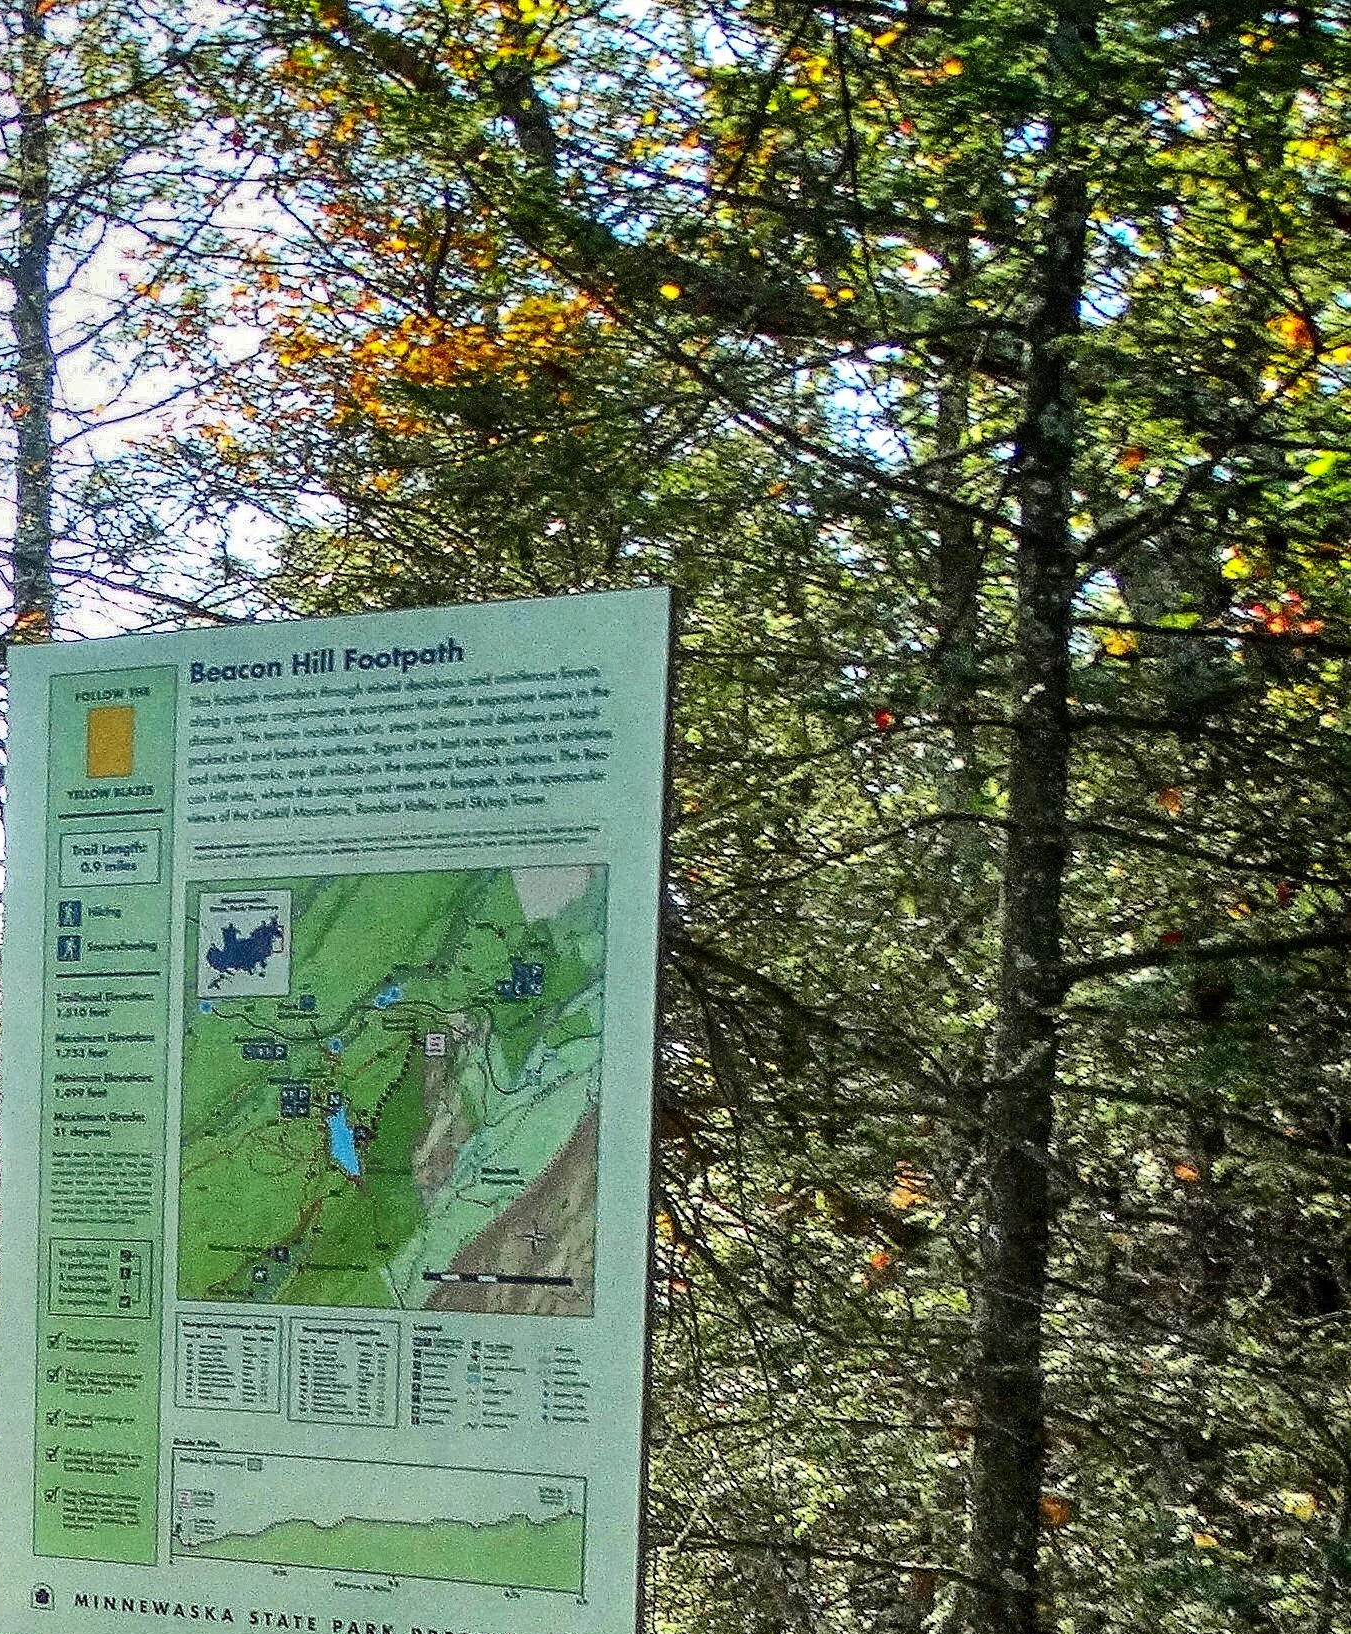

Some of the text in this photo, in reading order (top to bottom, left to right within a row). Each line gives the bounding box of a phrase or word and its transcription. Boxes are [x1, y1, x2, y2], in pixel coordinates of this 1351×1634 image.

[190, 638, 464, 684] Beacon Hill Footpath
[75, 688, 123, 701] FOLLOW
[67, 788, 110, 800] YELLOW
[72, 843, 97, 855] Trail
[74, 1593, 235, 1624] MINNEWASKA
[249, 1610, 317, 1632] STATE
